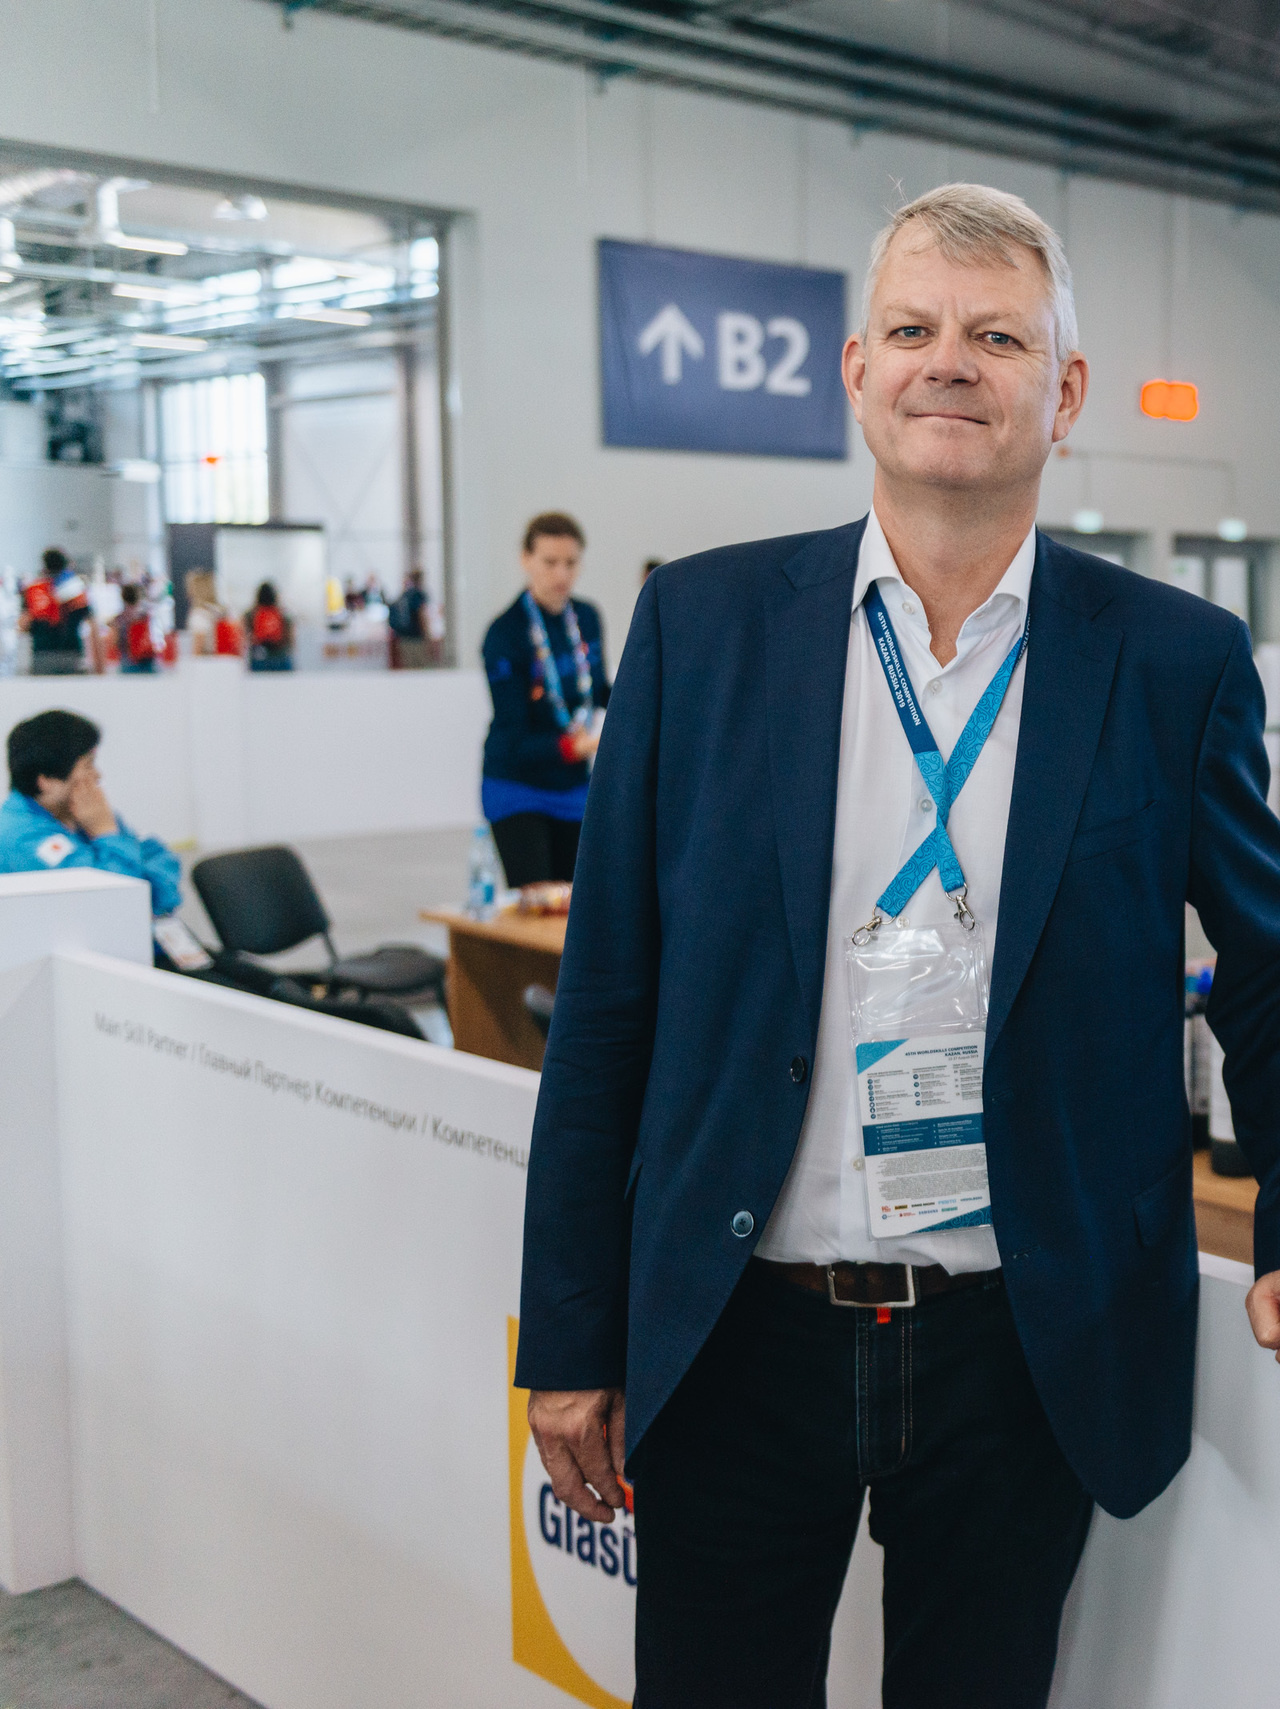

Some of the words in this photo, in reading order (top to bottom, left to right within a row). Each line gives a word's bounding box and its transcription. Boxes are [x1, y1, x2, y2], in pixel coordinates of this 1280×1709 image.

[717, 312, 812, 397] B2
[877, 611, 888, 631] 45TH
[884, 629, 903, 678] WORLDSKILLS
[900, 678, 922, 727] COMPETITION
[887, 664, 900, 691] RUSSIA
[895, 689, 906, 709] 2019
[315, 1079, 417, 1133] Компетенции
[432, 1114, 528, 1170] Компетенц
